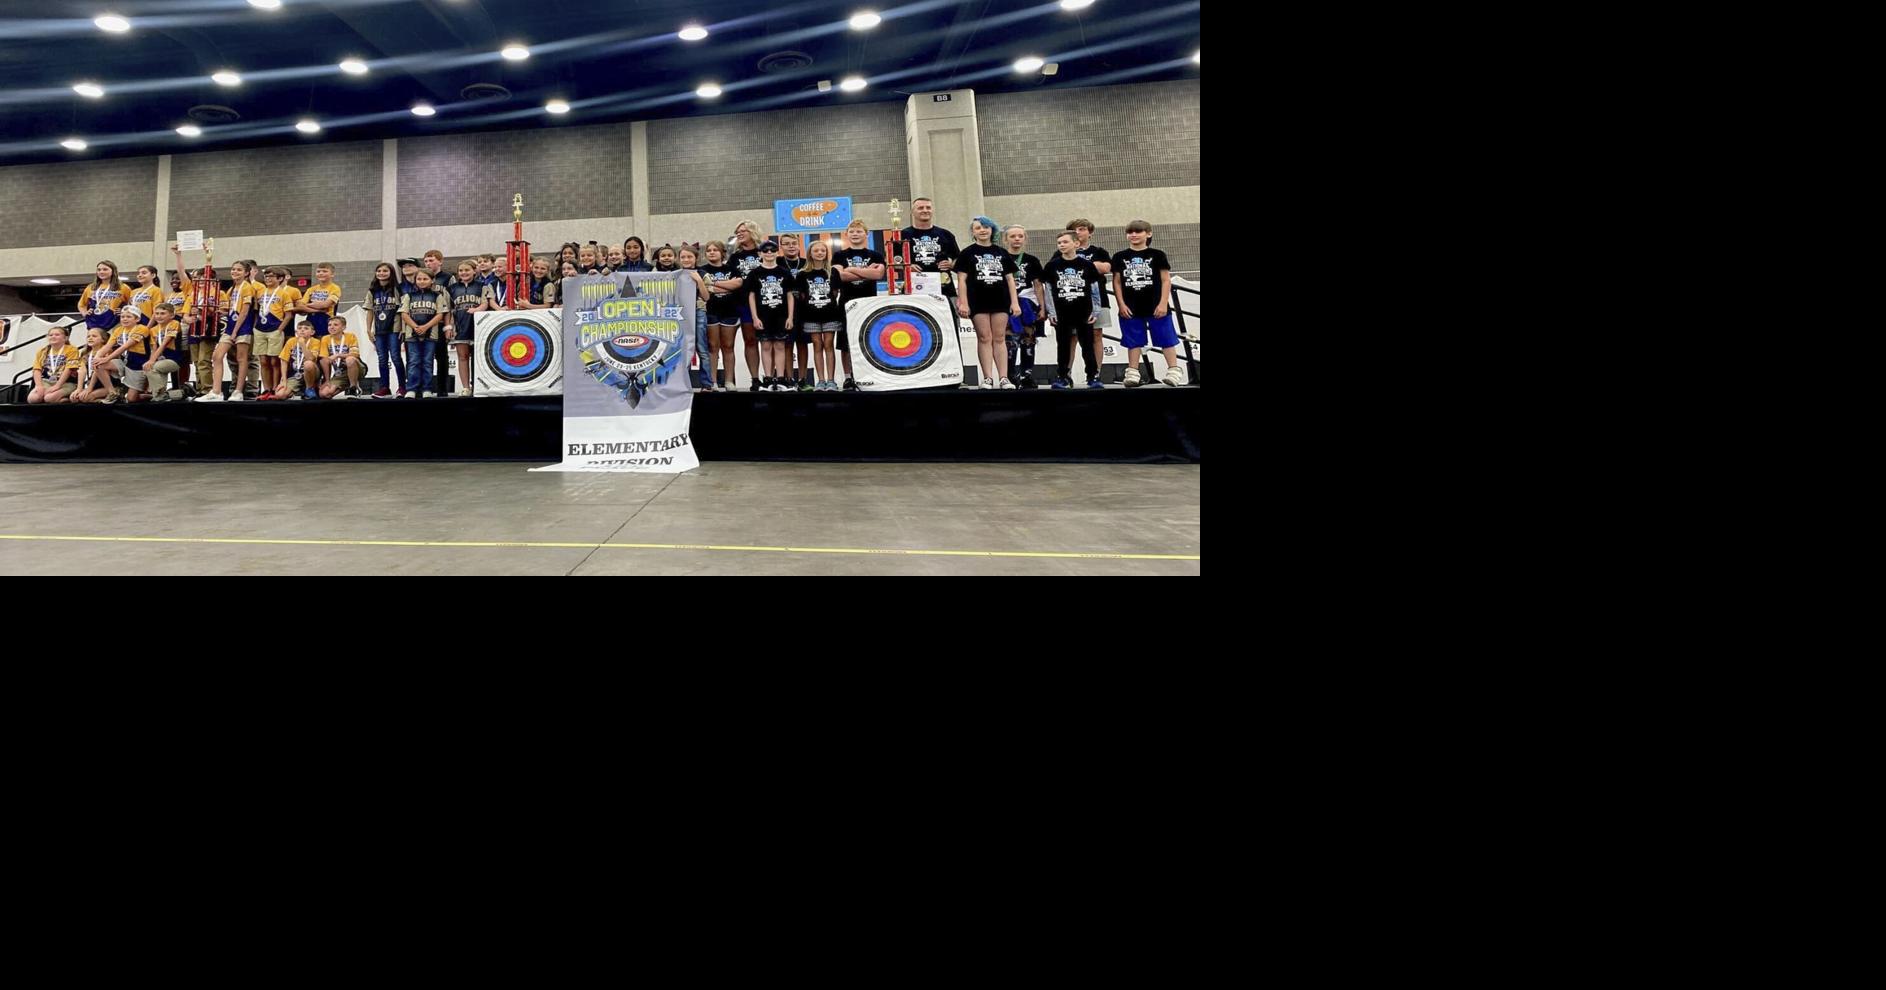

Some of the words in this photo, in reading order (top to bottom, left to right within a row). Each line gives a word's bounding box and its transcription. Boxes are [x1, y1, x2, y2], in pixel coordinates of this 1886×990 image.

[799, 202, 824, 212] COFFEE
[800, 216, 825, 226] DRINK
[603, 299, 655, 318] OPEN
[664, 309, 678, 318] 22
[582, 313, 595, 321] 20
[581, 320, 680, 347] CHAMPIONSHIP
[567, 432, 689, 456] ELEMENTARY
